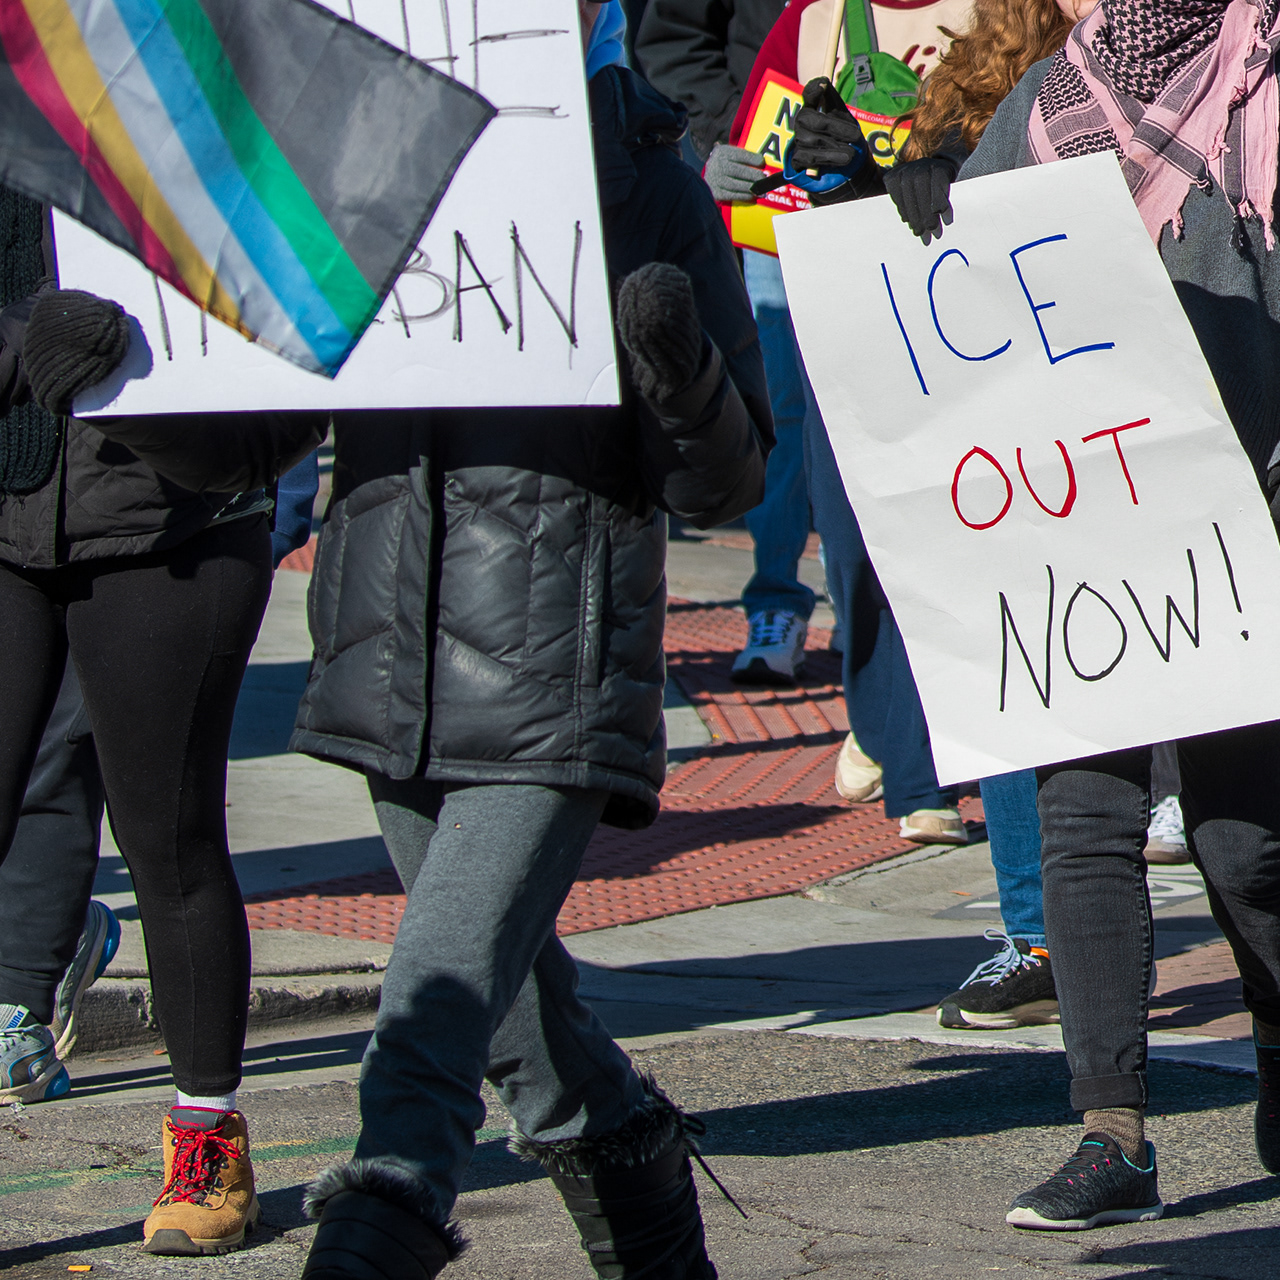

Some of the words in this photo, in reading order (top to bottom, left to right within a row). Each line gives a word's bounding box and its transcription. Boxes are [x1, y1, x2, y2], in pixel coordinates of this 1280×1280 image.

[881, 234, 1115, 395] ICE
[951, 417, 1151, 531] OUT
[998, 521, 1249, 713] NOW!
